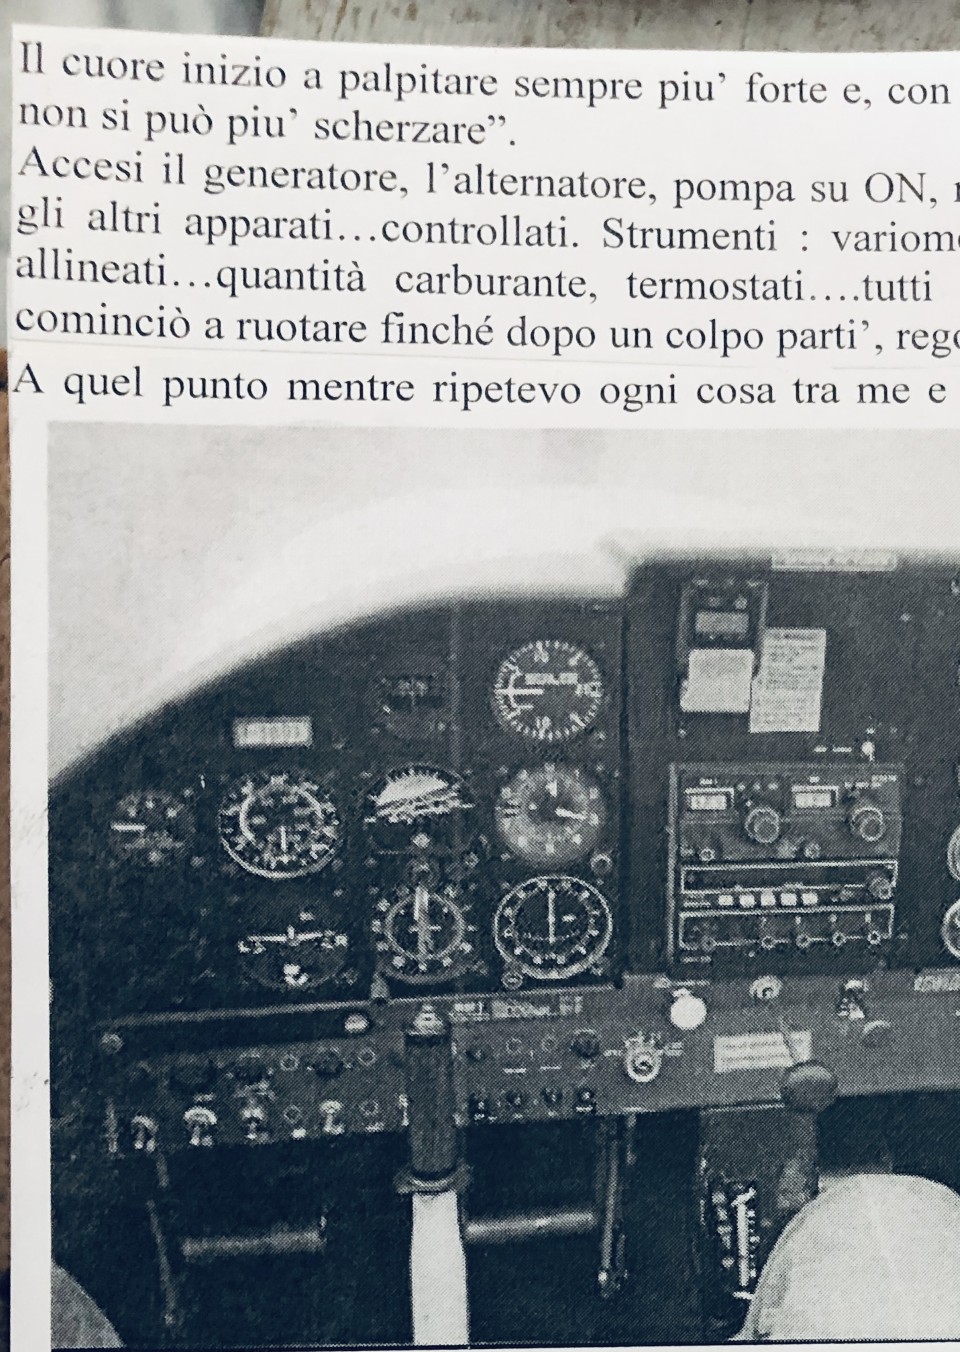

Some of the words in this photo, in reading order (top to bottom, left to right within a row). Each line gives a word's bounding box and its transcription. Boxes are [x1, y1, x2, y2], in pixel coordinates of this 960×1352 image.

[21, 41, 44, 74] Il
[62, 54, 165, 82] cuore
[182, 51, 287, 89] inizio
[303, 68, 323, 90] a
[339, 62, 498, 102] palpitare
[514, 75, 643, 109] sempre
[745, 71, 828, 104] forte
[843, 83, 872, 109] e,
[887, 83, 952, 105] con
[19, 145, 144, 183] Accesi
[162, 151, 185, 185] il
[203, 163, 408, 198] generatore,
[672, 178, 796, 211] pompa
[810, 180, 849, 203] su
[864, 171, 938, 209] ON,
[15, 301, 191, 339] cominciò
[204, 317, 225, 340] a
[236, 314, 368, 343] ruotare
[380, 311, 494, 347] finché
[506, 314, 596, 357] dopo
[609, 327, 654, 349] un
[665, 318, 764, 359] colpo
